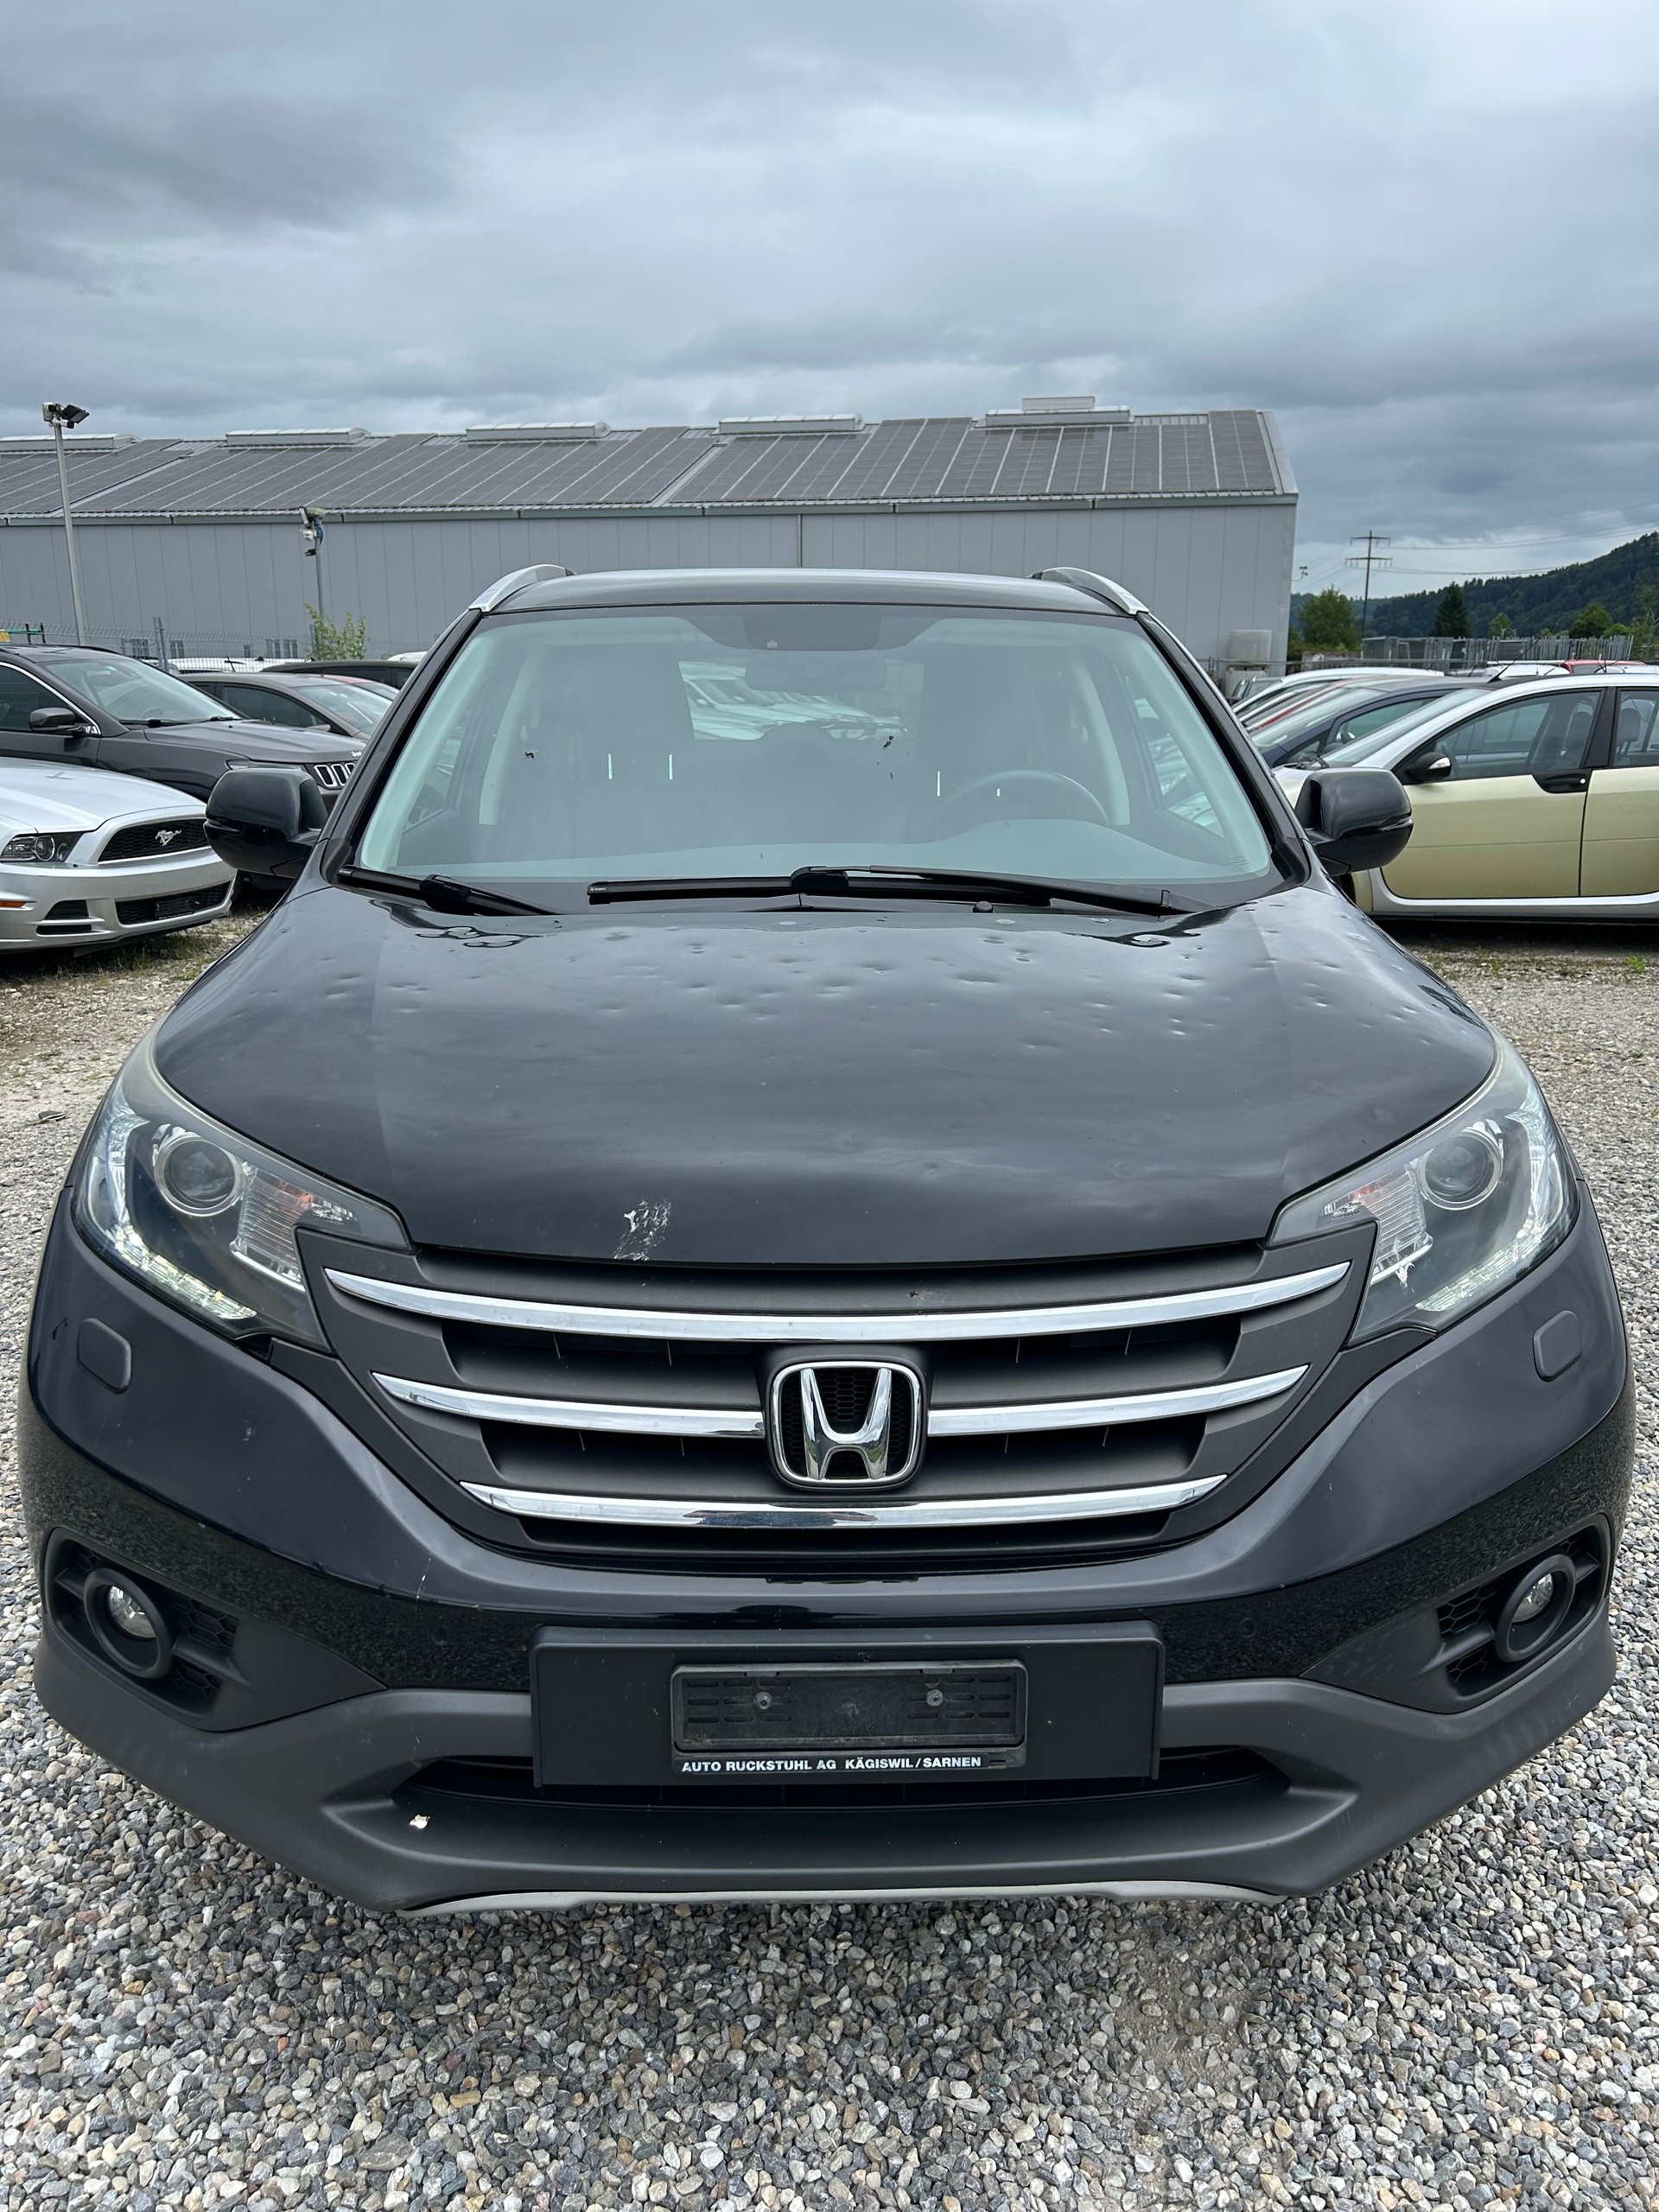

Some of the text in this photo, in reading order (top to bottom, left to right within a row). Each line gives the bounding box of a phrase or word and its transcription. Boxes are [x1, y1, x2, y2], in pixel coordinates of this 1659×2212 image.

[681, 1761, 722, 1772] AUTO
[726, 1759, 812, 1771] RUCKSTUHL
[816, 1759, 836, 1770] AG
